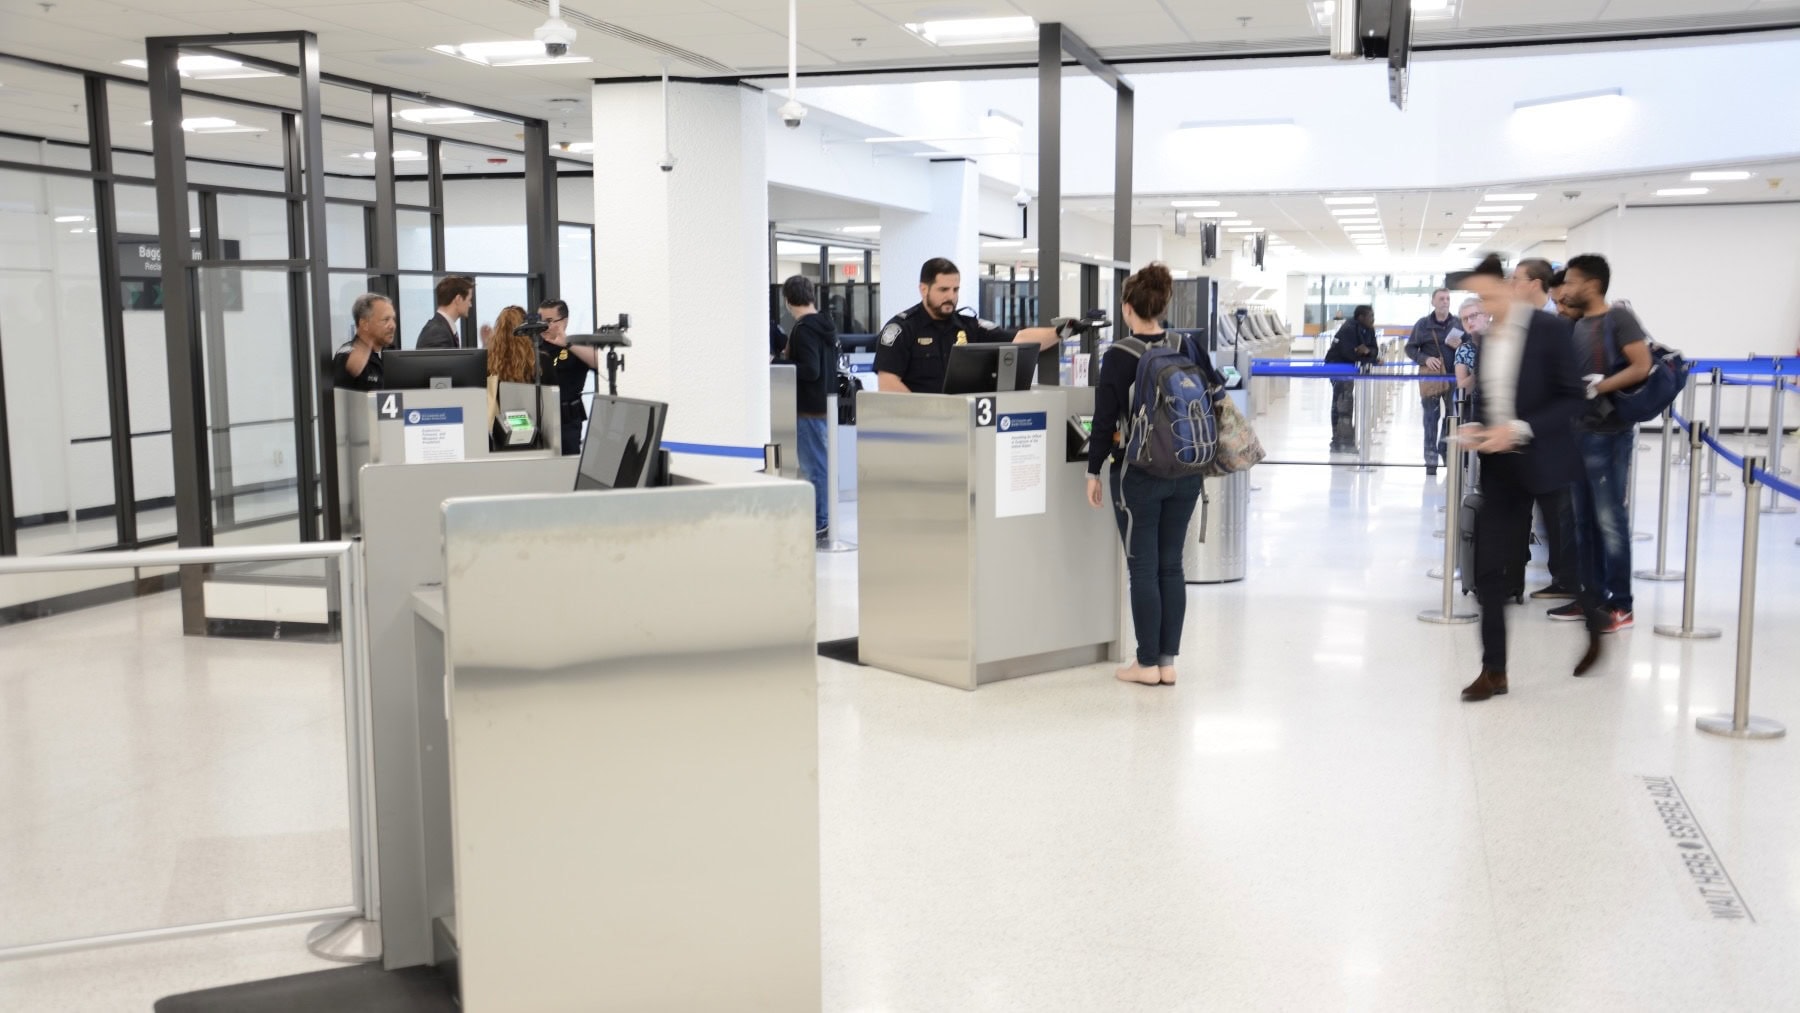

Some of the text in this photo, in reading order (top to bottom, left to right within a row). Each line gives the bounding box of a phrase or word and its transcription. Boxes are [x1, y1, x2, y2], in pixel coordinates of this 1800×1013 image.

[138, 246, 161, 261] Bagg
[381, 394, 398, 419] 4
[977, 397, 992, 426] 3
[1654, 799, 1700, 839] ESPERE
[1681, 853, 1726, 885] HERE
[1698, 887, 1745, 919] WAIT
